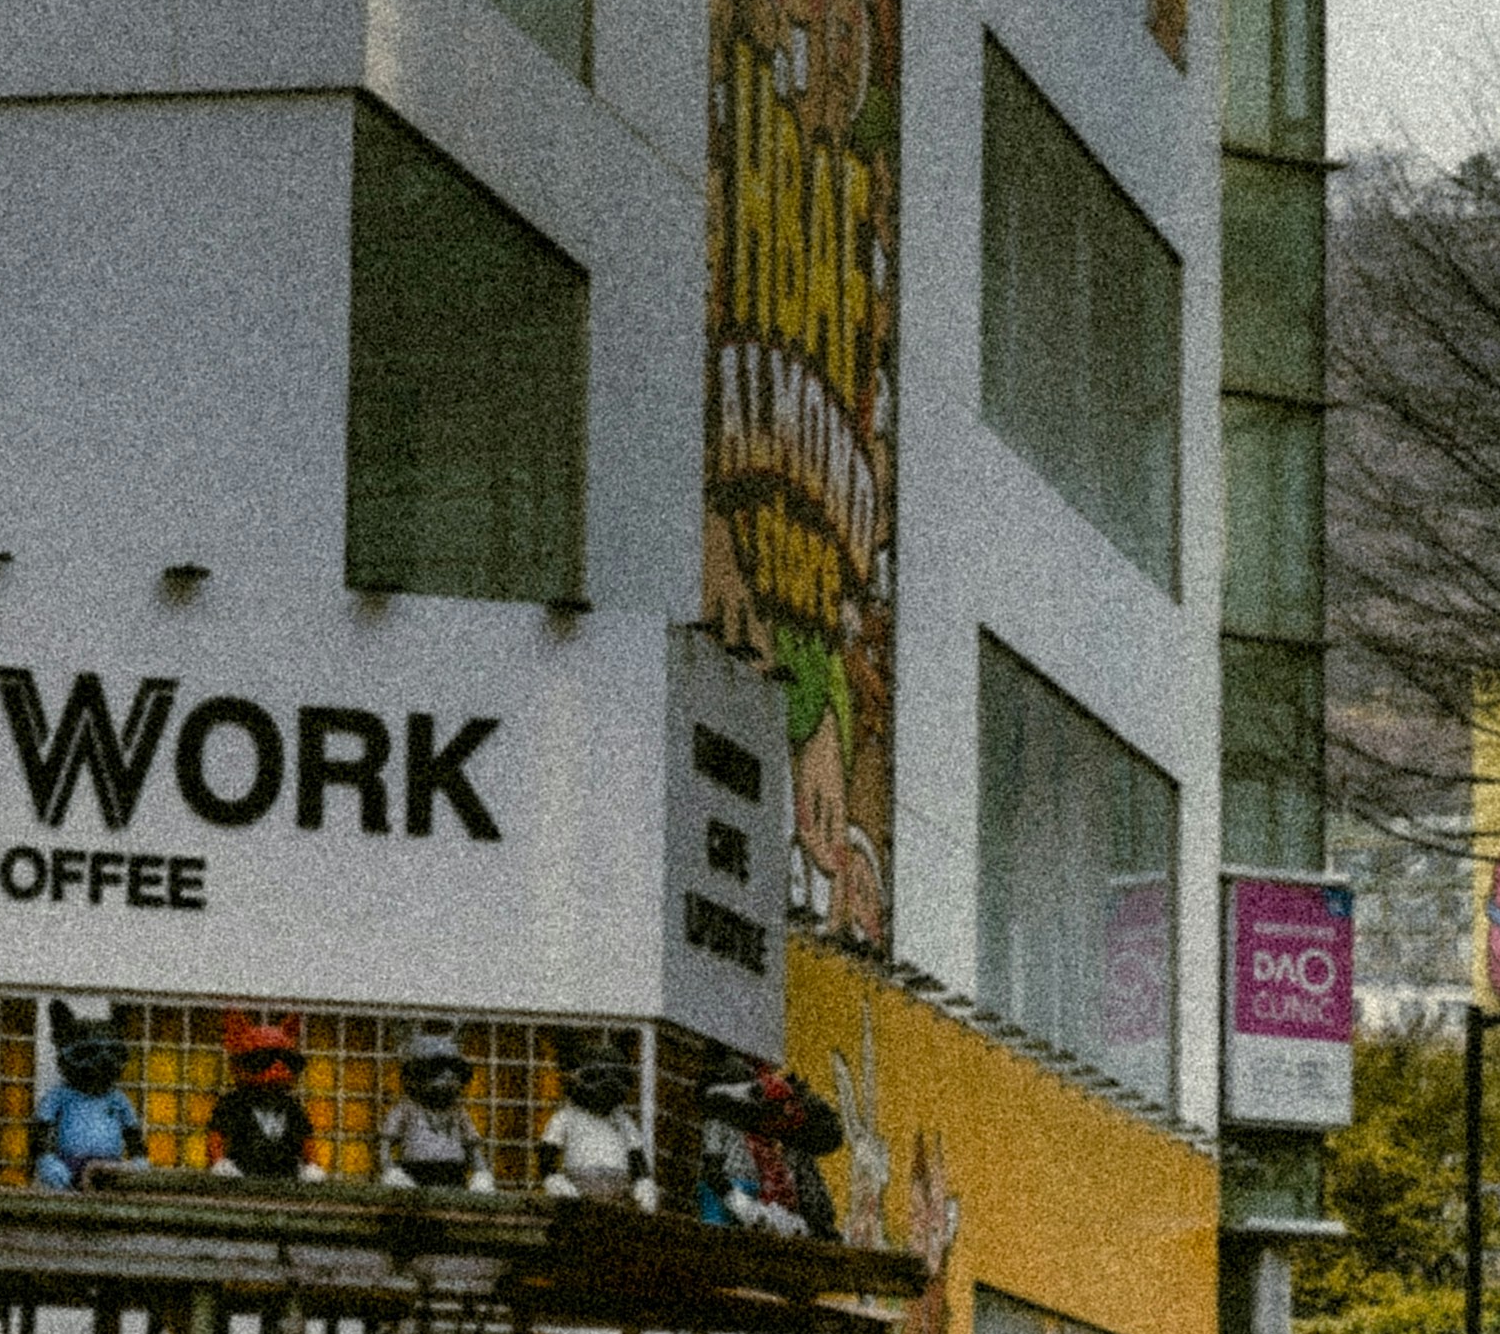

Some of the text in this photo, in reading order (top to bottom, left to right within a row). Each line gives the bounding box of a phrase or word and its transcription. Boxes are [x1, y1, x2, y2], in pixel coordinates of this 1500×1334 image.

[731, 35, 874, 413] HBAF
[715, 338, 877, 585] ALMOND
[1252, 990, 1337, 1026] CLINIC
